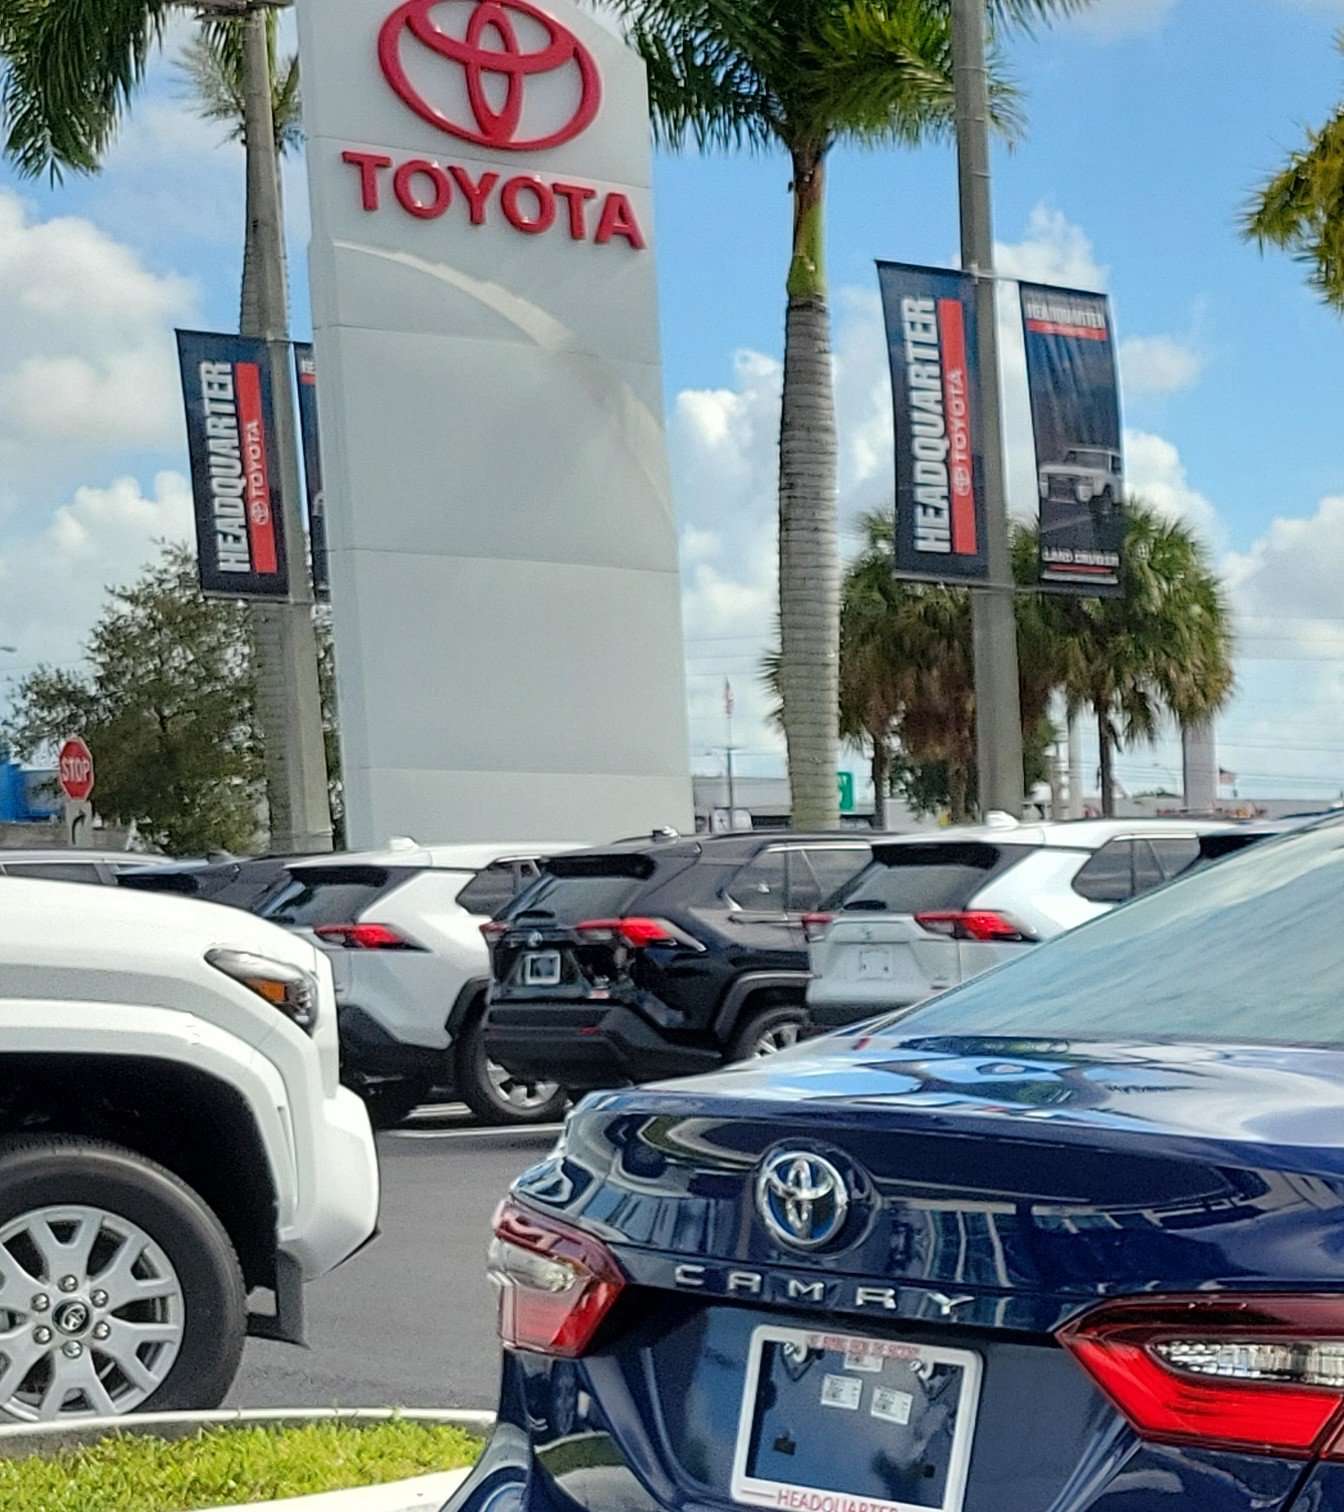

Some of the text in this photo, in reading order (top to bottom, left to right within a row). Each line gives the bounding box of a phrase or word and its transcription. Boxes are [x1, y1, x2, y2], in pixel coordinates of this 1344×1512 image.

[342, 151, 646, 250] TOYOTA
[246, 418, 265, 499] TOYOTA
[901, 296, 951, 552] HEADQUARTER
[946, 366, 969, 465] TOYOTA
[200, 360, 250, 572] HEADQUARTER
[61, 756, 90, 781] STOP
[674, 1264, 975, 1315] CAMRY
